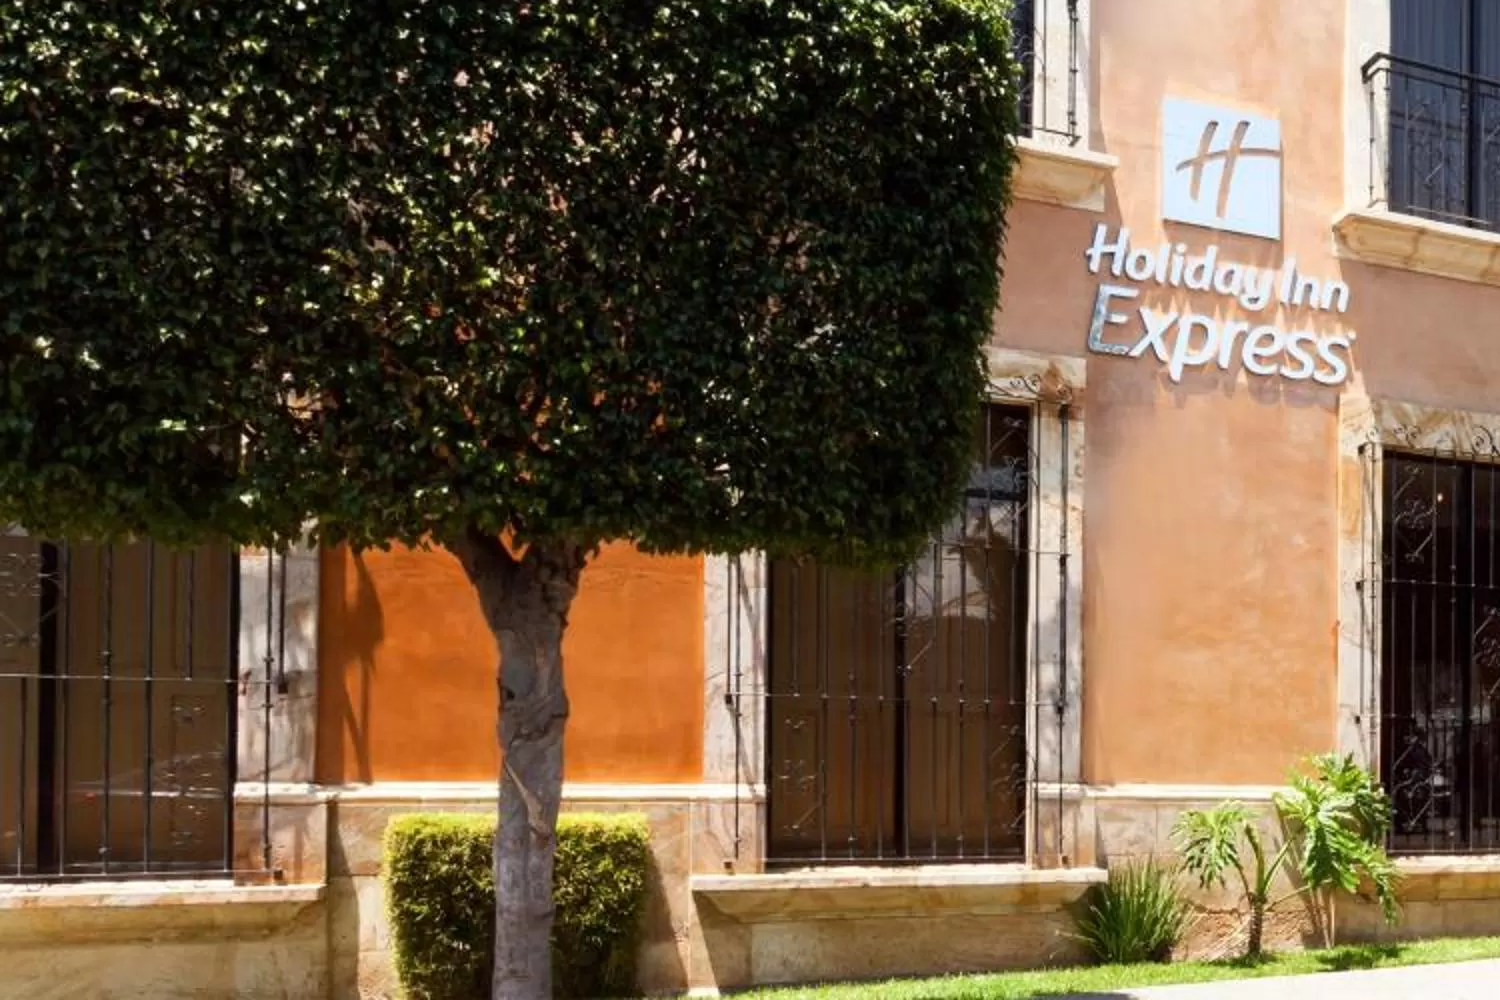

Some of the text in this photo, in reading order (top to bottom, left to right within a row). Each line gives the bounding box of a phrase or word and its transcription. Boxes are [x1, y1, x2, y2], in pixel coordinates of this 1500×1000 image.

[1086, 223, 1350, 313] Holiday Inn
[1087, 284, 1352, 384] Express
